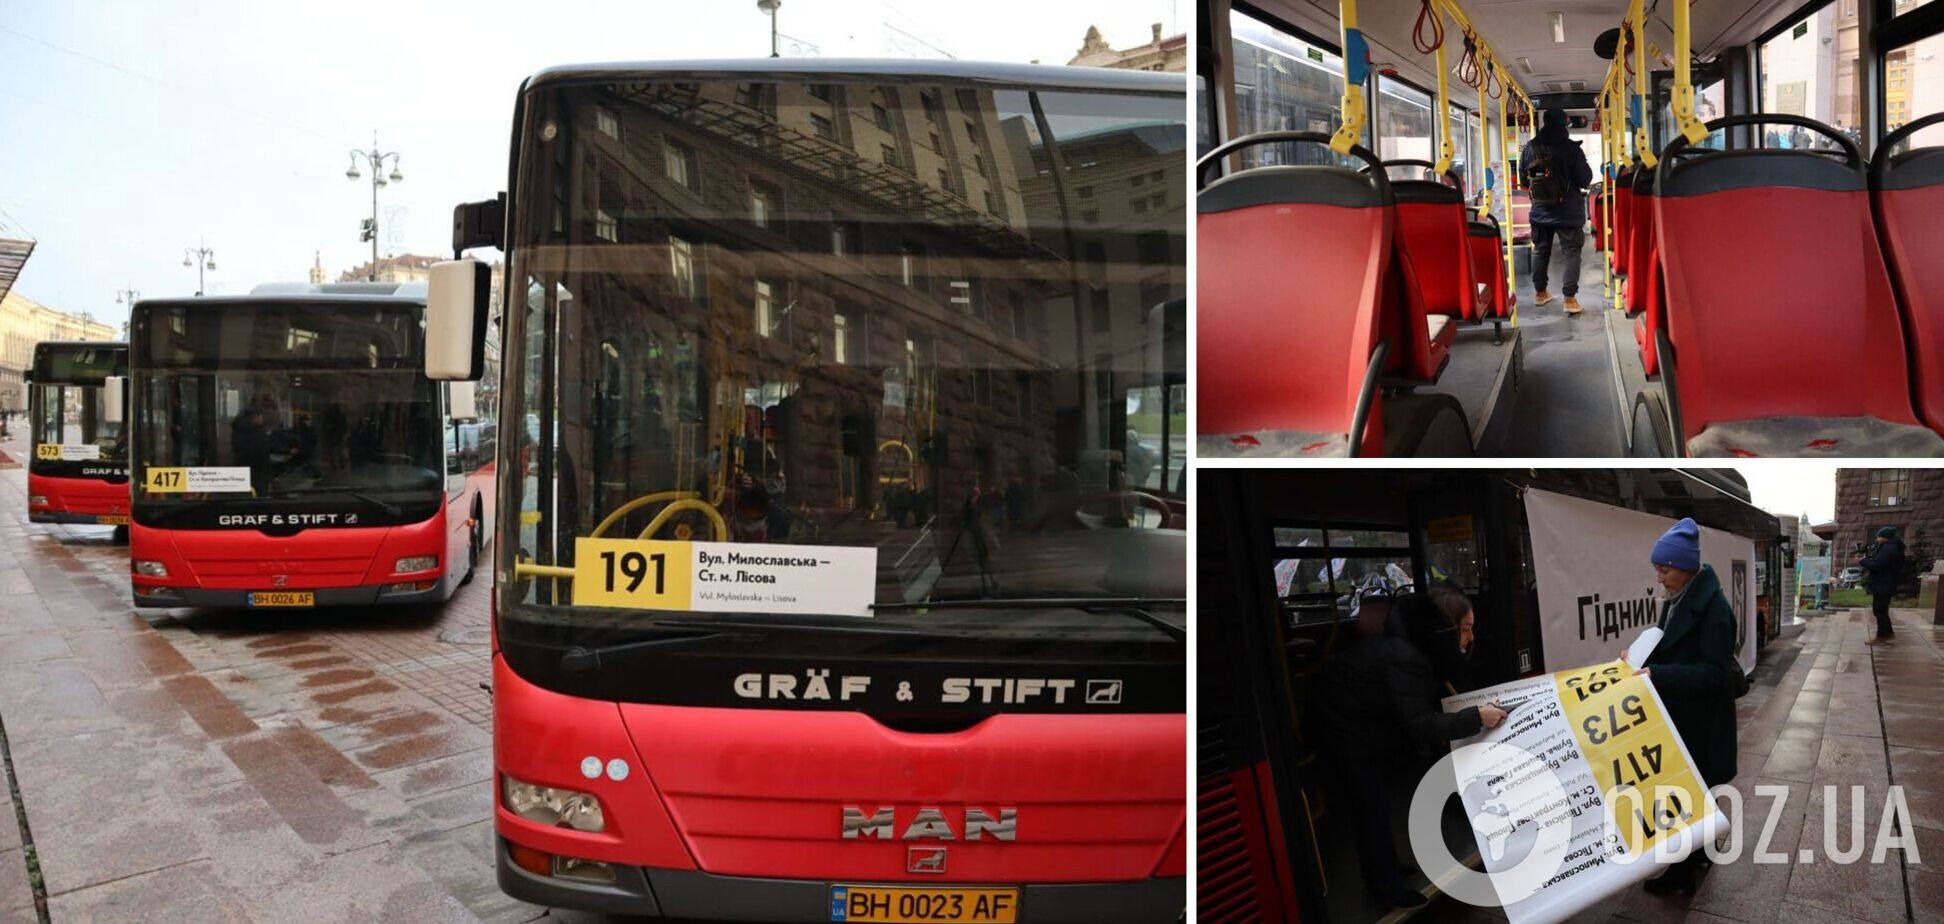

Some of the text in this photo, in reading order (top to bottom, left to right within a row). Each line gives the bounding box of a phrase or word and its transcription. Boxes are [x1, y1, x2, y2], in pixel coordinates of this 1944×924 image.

[41, 446, 58, 456] 573
[154, 472, 180, 487] 417
[272, 514, 284, 525] &
[288, 514, 338, 525] STIFT
[699, 551, 725, 566] Вул.
[728, 552, 817, 567] Милославська
[600, 551, 665, 595] 191
[698, 569, 776, 585] Ст. м. Лісова
[254, 593, 312, 604] BH 0026 AF
[1577, 587, 1657, 642] Гідний
[734, 669, 1076, 704] GRÄF & STIFT
[1582, 695, 1647, 745] 573
[1557, 747, 1579, 765] Вул.
[1612, 743, 1663, 792] 417
[1579, 783, 1595, 797] Ст.
[1579, 793, 1602, 812] Вул.
[842, 806, 1017, 841] MAN
[1635, 791, 1692, 839] 191
[1562, 843, 1593, 866] Лісова
[833, 908, 846, 916] UA
[850, 893, 1012, 920] BH 0023 AF
